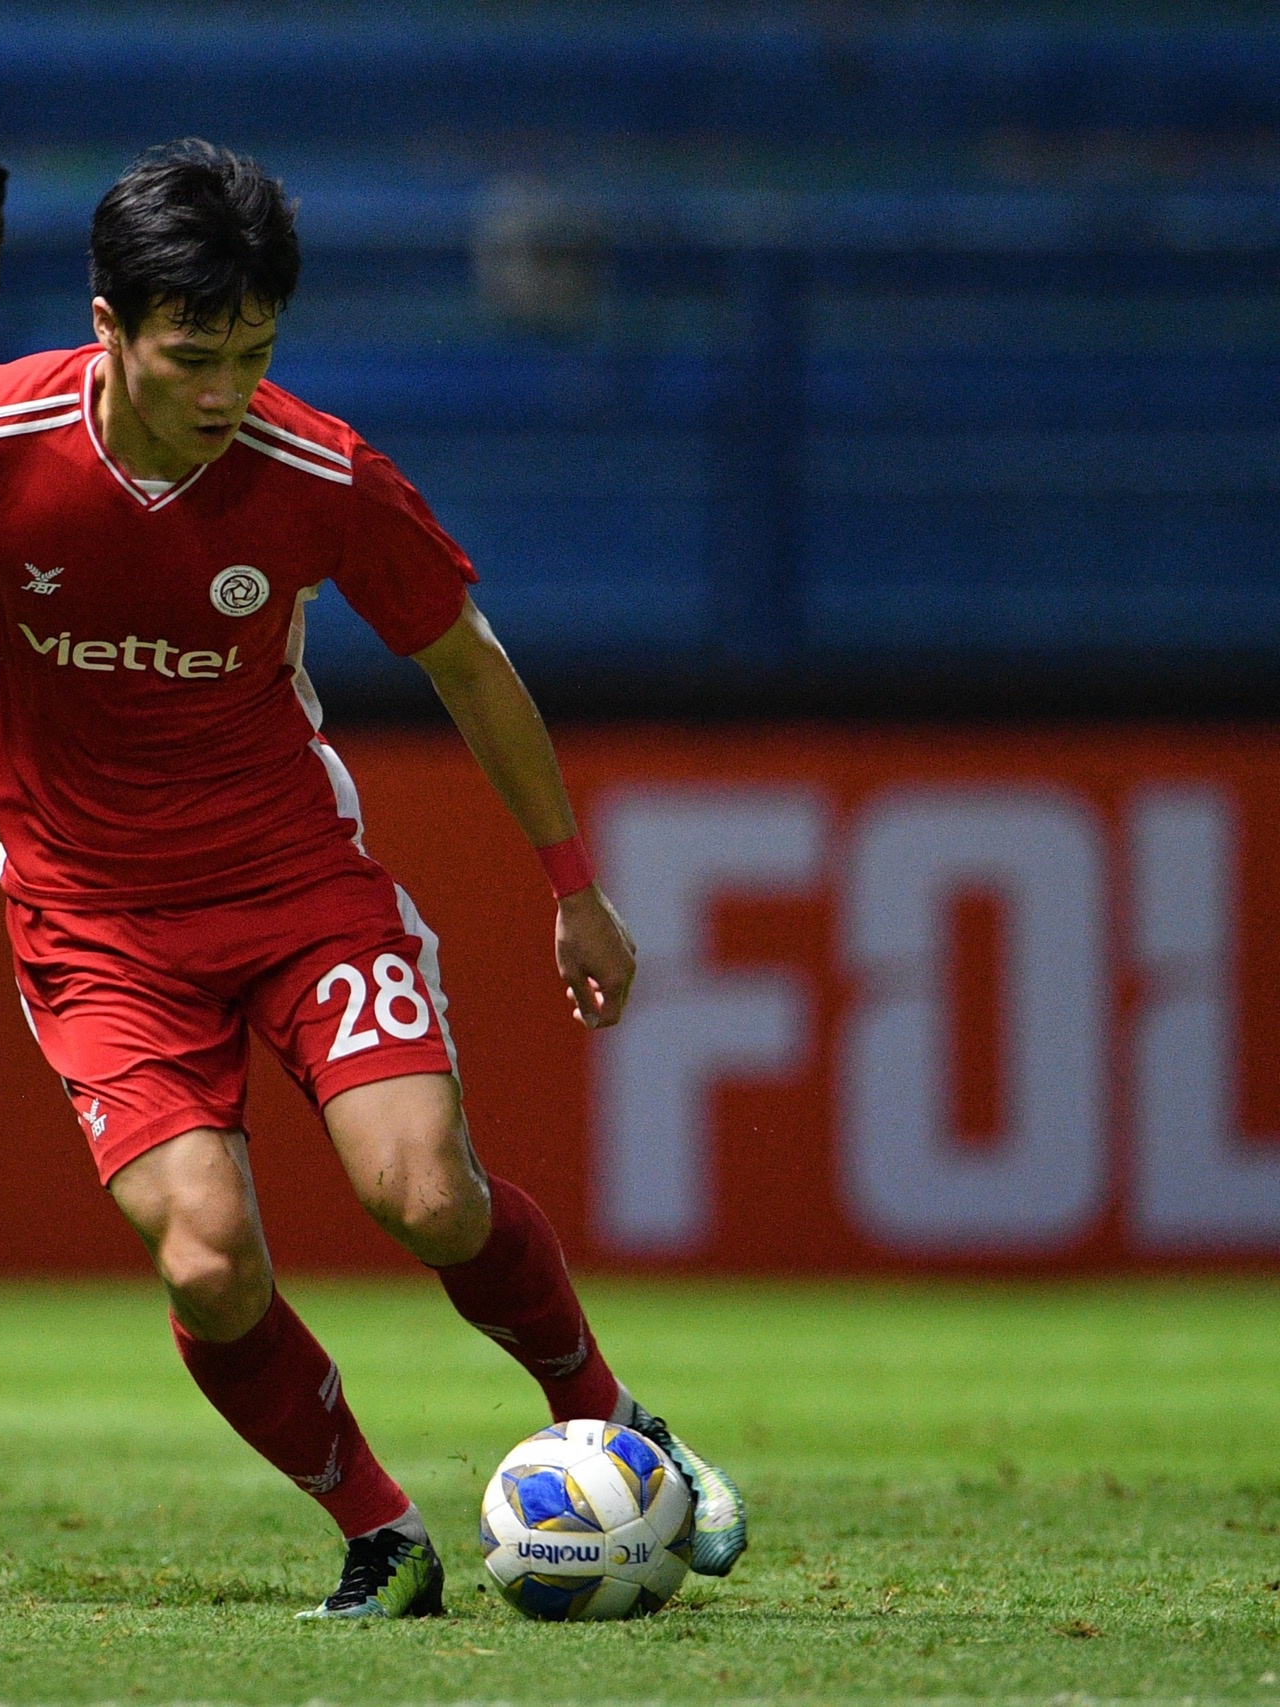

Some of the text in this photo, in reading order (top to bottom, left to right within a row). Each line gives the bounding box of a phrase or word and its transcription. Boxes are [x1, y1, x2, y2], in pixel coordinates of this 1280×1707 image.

[20, 581, 62, 595] FBT
[317, 953, 430, 1062] 28
[517, 1541, 600, 1565] molten
